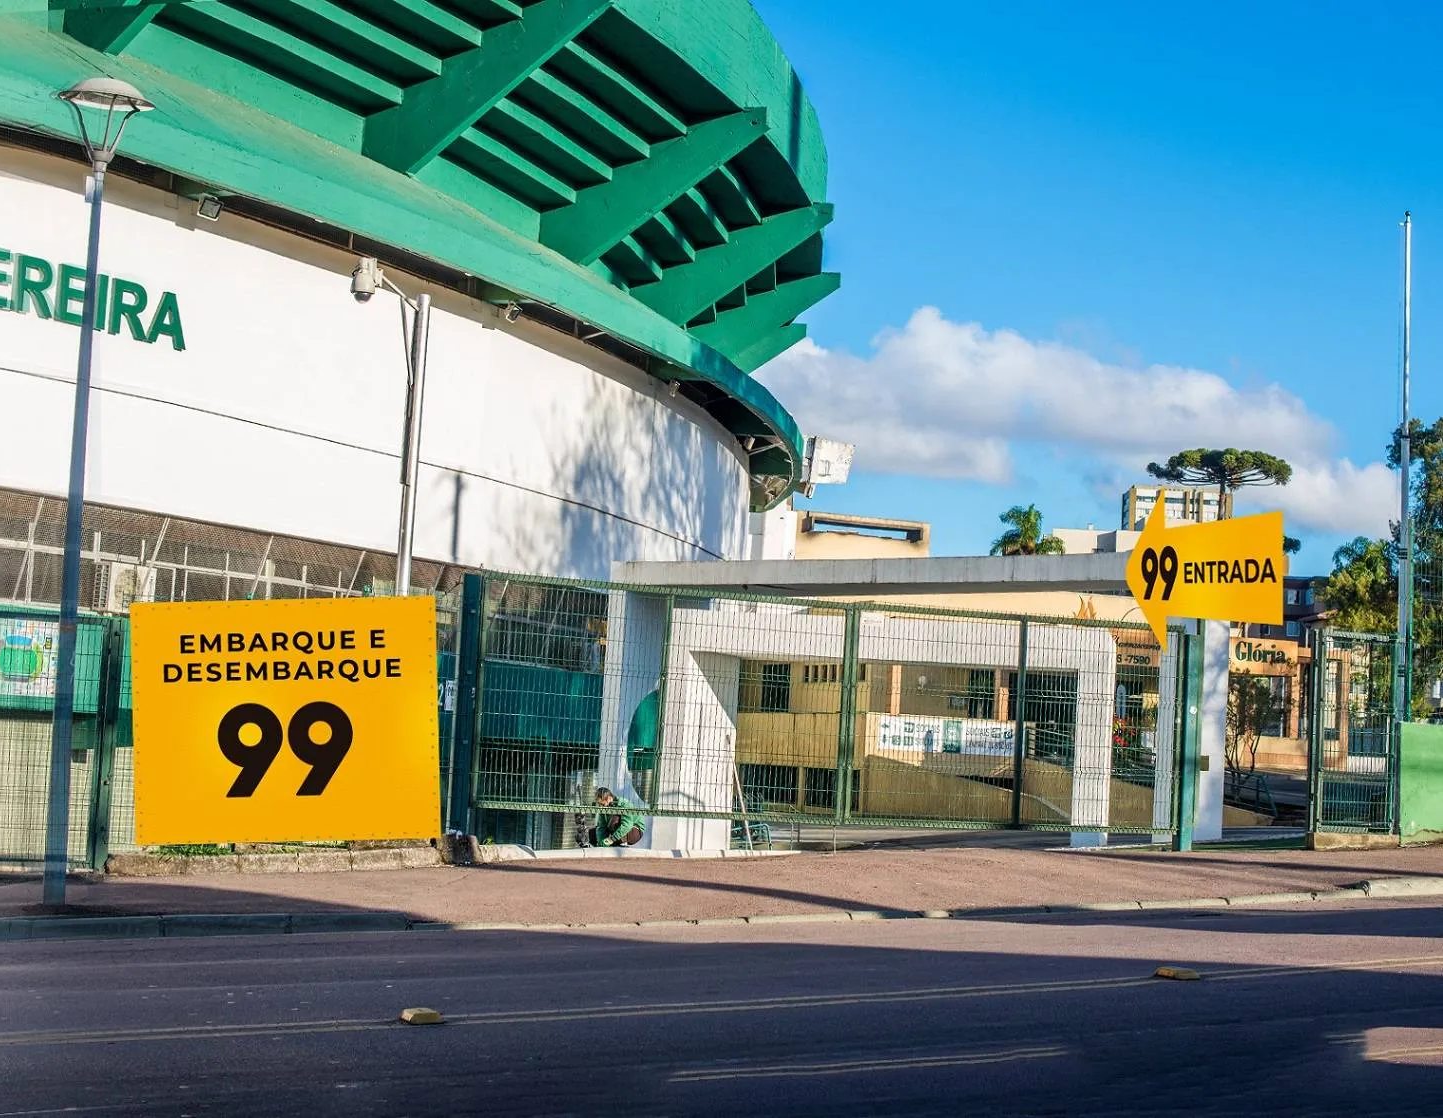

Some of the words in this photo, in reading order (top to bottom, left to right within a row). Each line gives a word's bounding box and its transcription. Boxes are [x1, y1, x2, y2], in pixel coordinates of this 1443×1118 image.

[1141, 545, 1178, 601] 99
[1184, 558, 1277, 584] ENTRADA
[180, 630, 356, 655] EMBARQUE
[370, 629, 386, 648] E
[1235, 640, 1286, 665] Glória
[163, 658, 402, 683] DESEMBARQUE
[217, 701, 353, 798] 99
